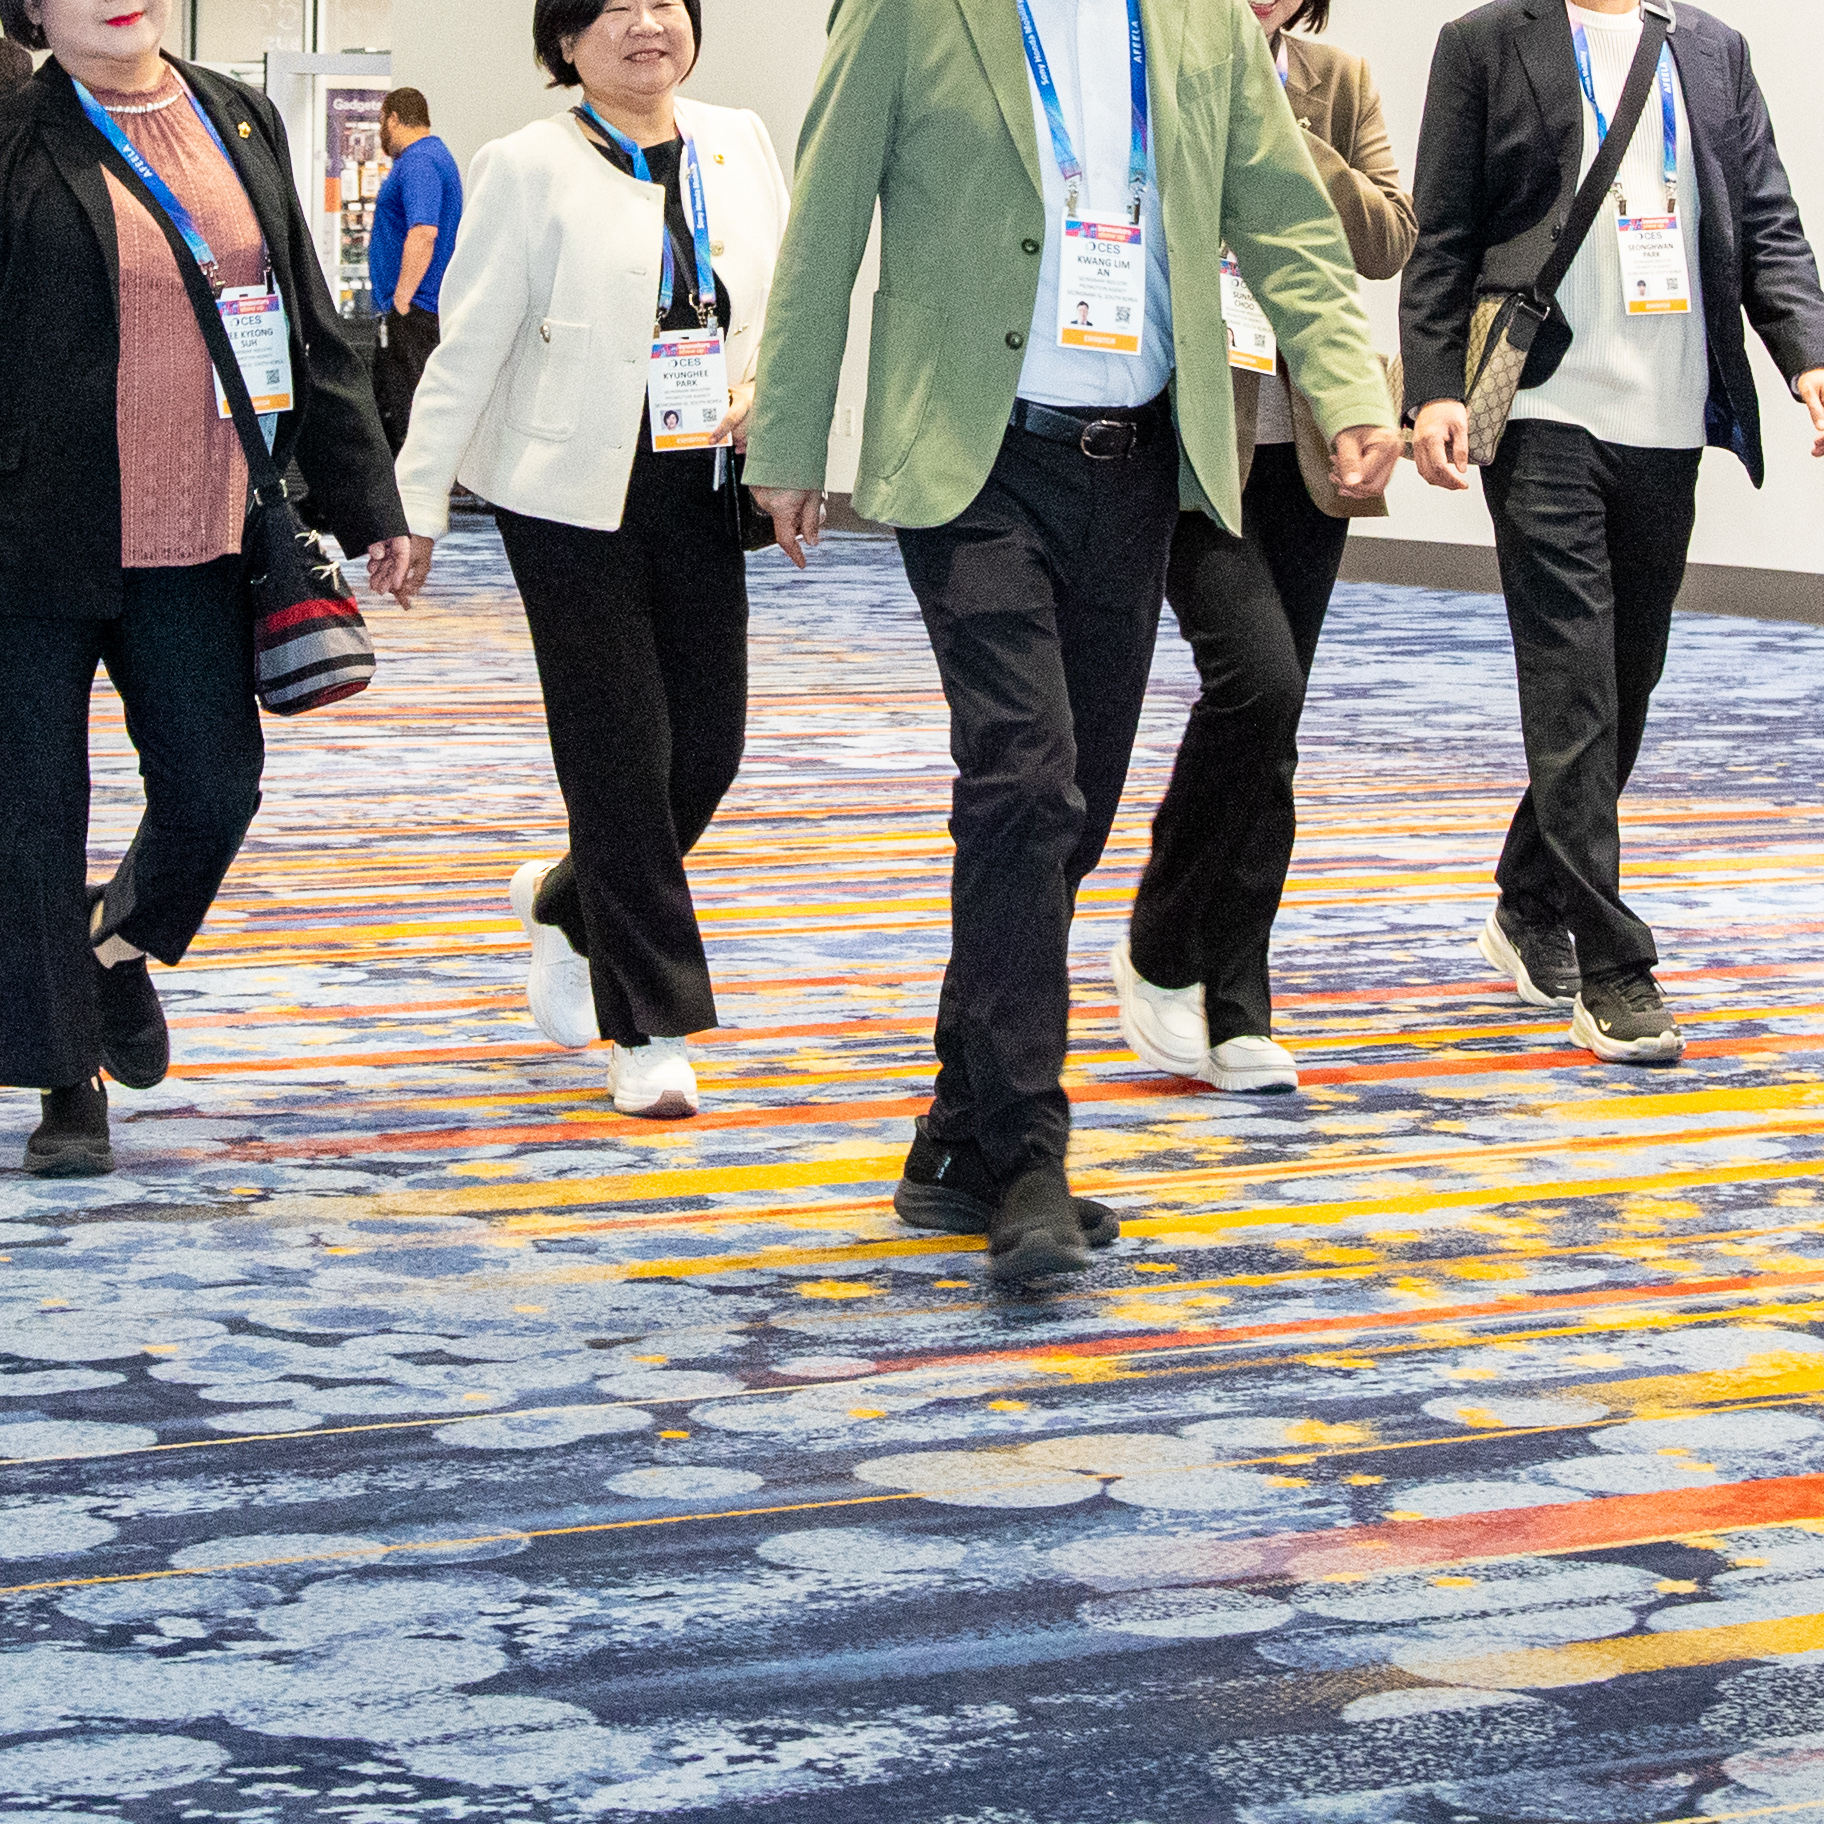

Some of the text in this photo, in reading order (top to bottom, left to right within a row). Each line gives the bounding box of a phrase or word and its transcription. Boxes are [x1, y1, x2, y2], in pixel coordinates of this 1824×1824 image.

[1017, 0, 1050, 86] Sony Honda Mobility
[1131, 21, 1143, 64] AFEELA
[1644, 232, 1662, 240] CES
[1097, 242, 1121, 255] CES
[1077, 256, 1130, 269] KWANG LIM
[1097, 269, 1110, 277] AN
[241, 316, 262, 325] CES
[241, 328, 273, 339] KYEONG
[241, 339, 258, 348] SUH
[680, 358, 702, 367] CES
[663, 370, 708, 380] KYUNGHEE
